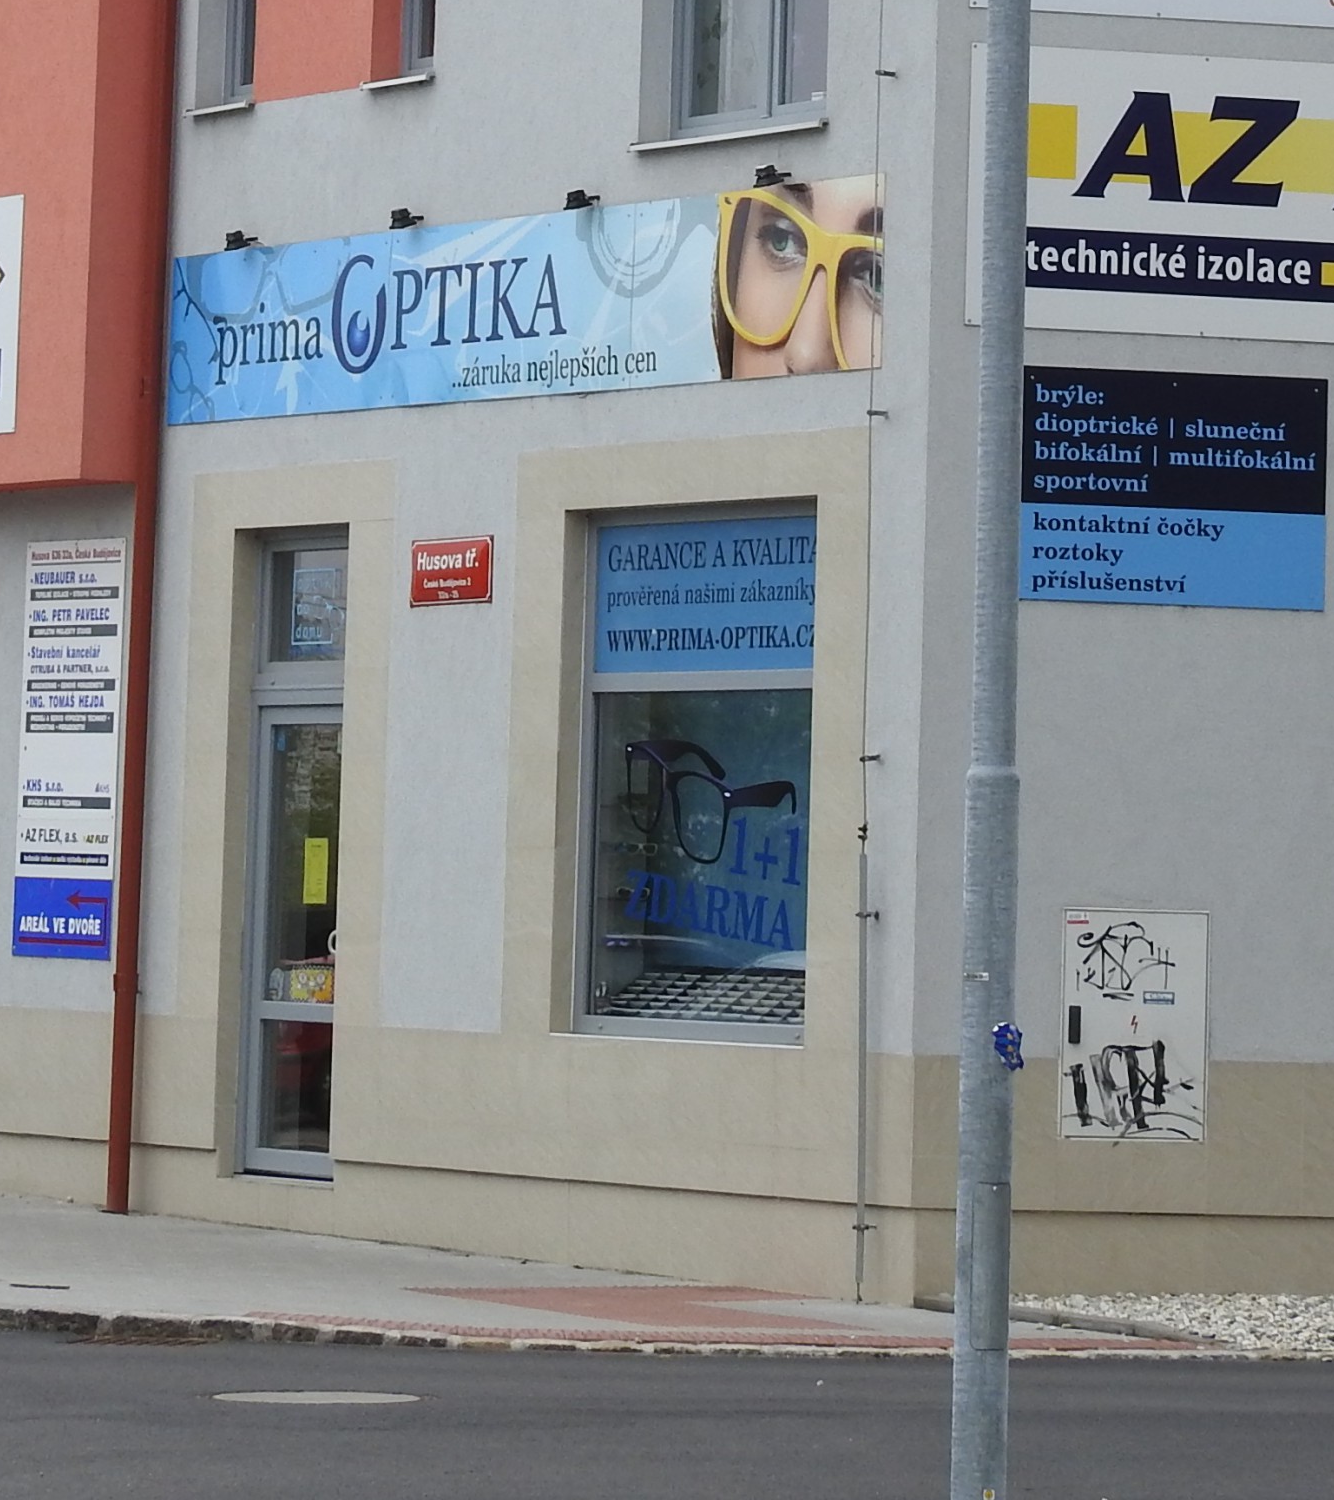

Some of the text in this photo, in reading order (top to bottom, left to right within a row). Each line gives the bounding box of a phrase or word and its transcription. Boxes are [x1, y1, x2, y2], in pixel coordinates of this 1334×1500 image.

[1071, 90, 1301, 208] AZ
[1025, 238, 1187, 279] technické
[1196, 245, 1312, 285] izolace
[213, 254, 567, 385] prima OPTIKA
[526, 346, 620, 389] nejlepších
[624, 348, 658, 375] cen
[1035, 383, 1105, 407] brýle:
[1035, 412, 1286, 442] dioptrické sluneční
[1034, 441, 1316, 472] bifokální multifokální
[1033, 473, 1149, 494] sportovní
[1033, 511, 1225, 542] kontaktní čočky
[417, 547, 479, 572] Husova tř.
[607, 540, 707, 572] GARANCE
[712, 539, 727, 568] A
[1032, 543, 1124, 567] roztoky
[33, 571, 76, 586] NEUBAUER
[1031, 570, 1187, 594] příslušenství
[607, 576, 816, 613] prověřená našimi zákazníky
[32, 607, 110, 623] ING. PETR PAVELEC
[29, 695, 46, 708] ING.
[78, 695, 105, 708] HEJDA
[24, 828, 37, 843] AZ
[38, 828, 63, 844] FLEX,
[729, 816, 801, 886] 1+1
[19, 911, 101, 935] AREÁL VE DVOŘE
[623, 869, 794, 950] ZDARMA
